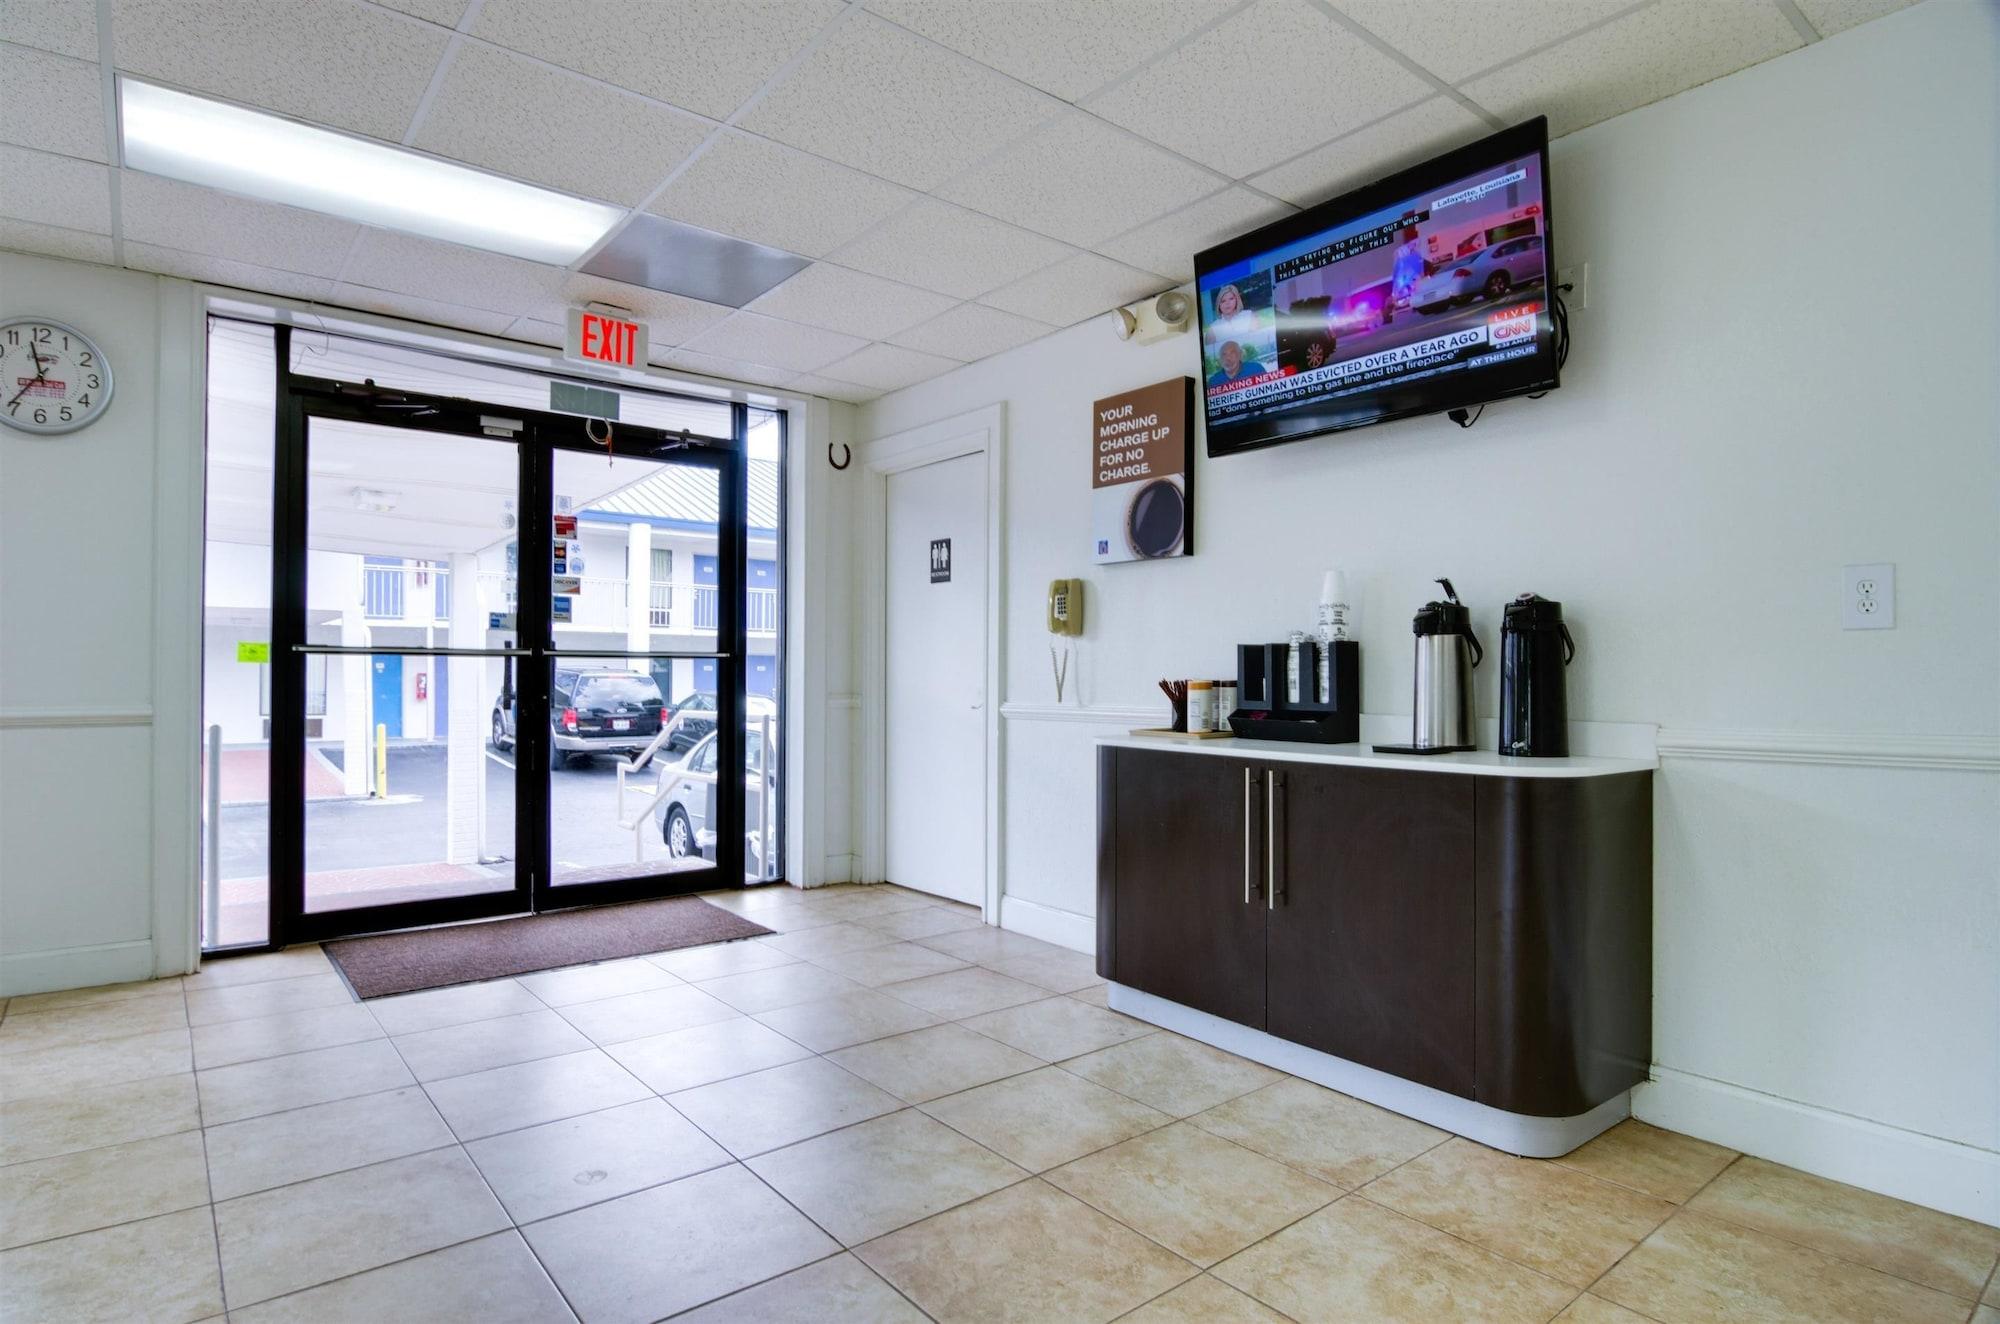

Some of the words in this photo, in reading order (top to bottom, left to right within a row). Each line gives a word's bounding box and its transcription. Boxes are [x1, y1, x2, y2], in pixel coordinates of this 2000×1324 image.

[1480, 174, 1520, 192] Louisiana
[1291, 258, 1299, 266] IS
[1304, 247, 1331, 261] TRYING
[1335, 242, 1345, 250] TO
[1349, 230, 1378, 245] FIGURE
[1383, 223, 1398, 233] OUT
[1402, 215, 1419, 227] WHO
[1279, 269, 1296, 279] THIS
[1300, 263, 1314, 273] MAN
[1318, 258, 1327, 266] IS
[1331, 252, 1345, 261] AND
[1349, 245, 1364, 255] WHY
[1369, 237, 1389, 248] THIS
[1494, 306, 1529, 321] LIVE
[7, 330, 19, 345] 11
[32, 327, 52, 344] 12
[1494, 319, 1532, 339] CNN
[62, 336, 68, 351] 1
[582, 314, 638, 365] EXIT
[79, 352, 92, 367] 2
[1470, 358, 1483, 367] AT
[1485, 353, 1506, 363] THIS
[1507, 346, 1536, 358] HOUR
[1208, 391, 1243, 407] HERIFF:
[1245, 381, 1287, 398] GUNMAN
[1289, 373, 1313, 387] WAS
[1316, 361, 1362, 383] EVICTED
[1365, 352, 1397, 368] OVER
[1400, 349, 1409, 360] A
[1412, 340, 1446, 356] YEAR
[1449, 331, 1479, 347] AGO
[1255, 369, 1286, 383] NEWS
[87, 373, 99, 389] 3
[1248, 391, 1294, 408] something
[1296, 388, 1306, 396] to
[1307, 383, 1323, 393] the
[1325, 379, 1343, 390] gas
[1344, 373, 1362, 384] line
[1363, 367, 1384, 380] and
[1386, 363, 1404, 375] the
[7, 401, 21, 416] 7
[78, 393, 90, 408] 4
[34, 408, 47, 424] 6
[60, 406, 72, 421] 5
[1100, 405, 1133, 422] YOUR
[1100, 414, 1158, 438] MORNING
[1100, 431, 1149, 452] CHARGE
[1152, 426, 1170, 441] UP
[1100, 452, 1123, 467] FOR
[1126, 448, 1144, 461] NO
[1099, 463, 1152, 482] CHARGE.
